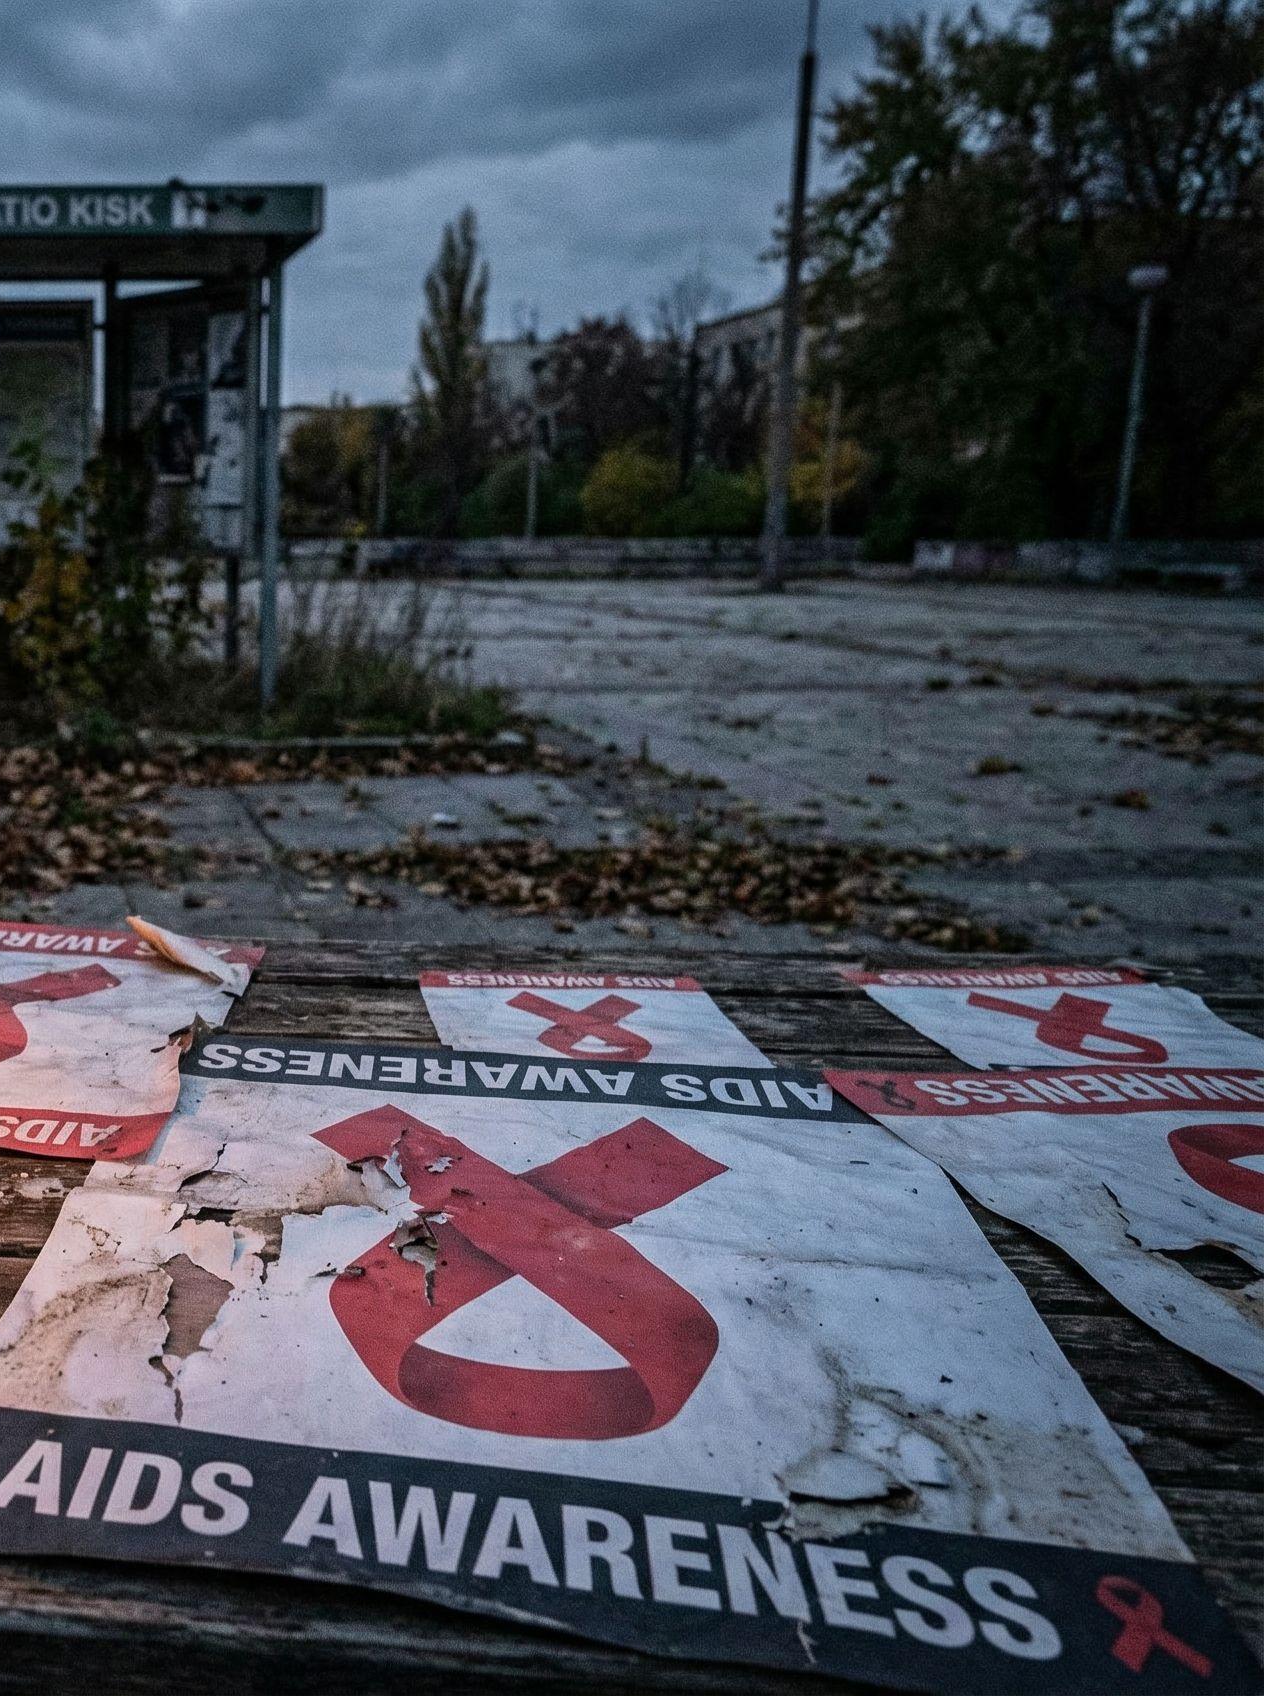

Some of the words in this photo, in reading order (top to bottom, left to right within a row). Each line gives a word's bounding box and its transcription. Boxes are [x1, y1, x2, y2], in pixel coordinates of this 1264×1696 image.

[69, 194, 154, 228] KISK
[446, 973, 605, 987] AWARENESS
[616, 976, 676, 989] AIDS
[197, 1043, 635, 1097] AWARENESS
[664, 1073, 834, 1111] AIDS
[281, 1475, 1062, 1659] AWARENESS
